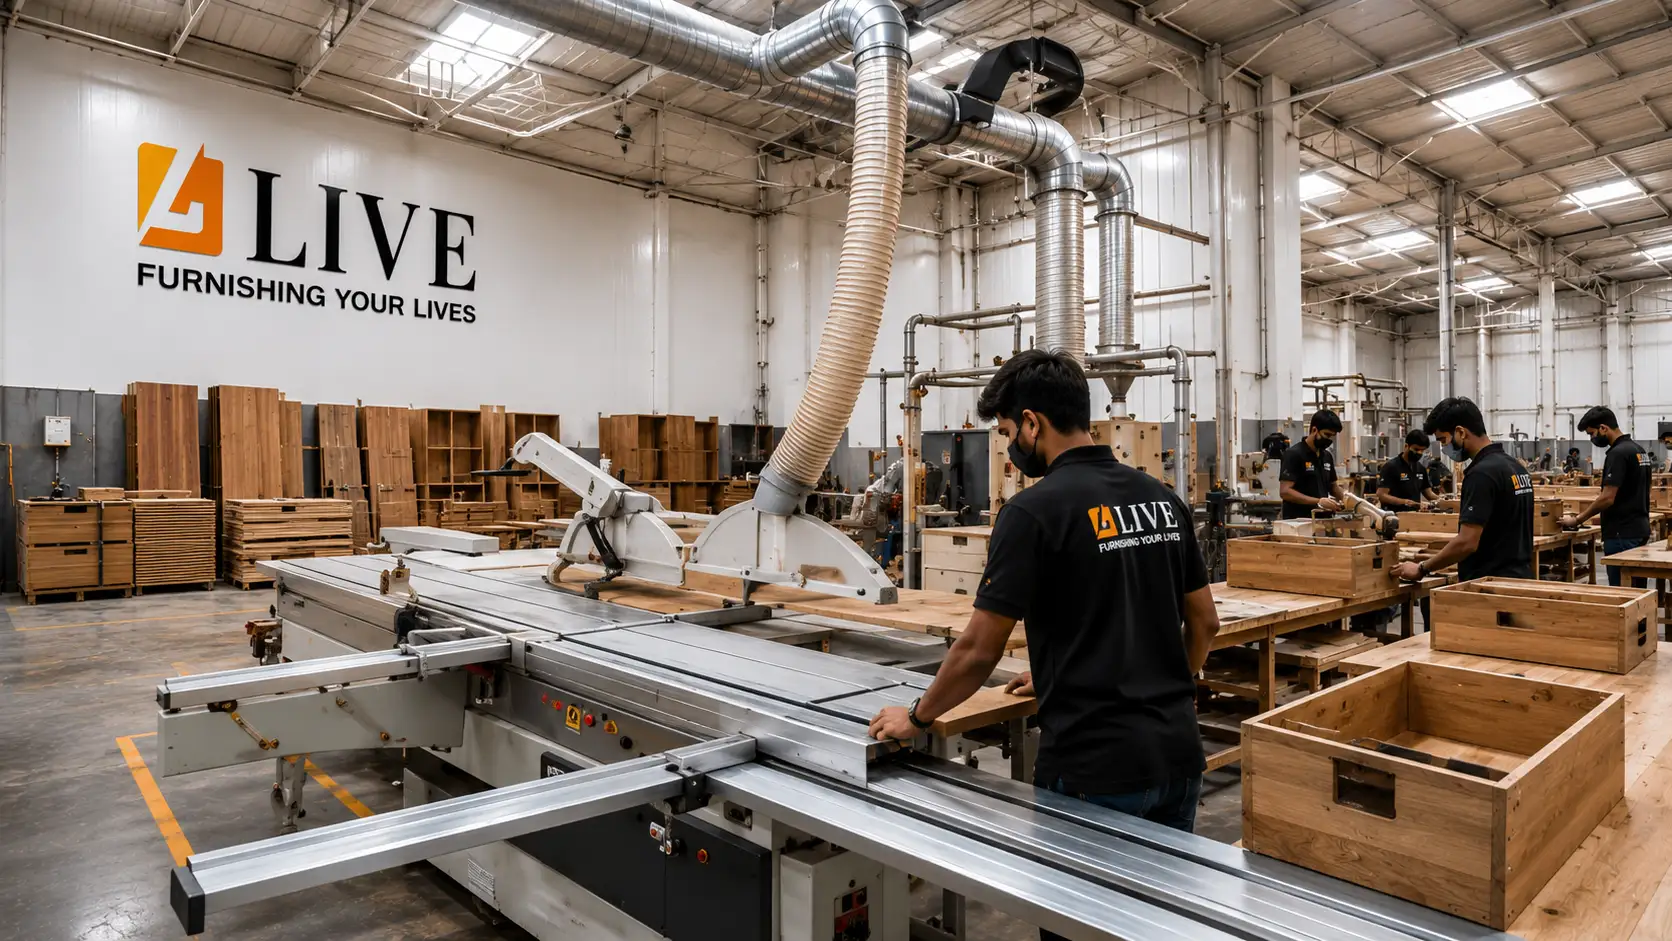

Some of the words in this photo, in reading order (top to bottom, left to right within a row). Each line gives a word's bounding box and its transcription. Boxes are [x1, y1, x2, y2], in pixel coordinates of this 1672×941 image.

[137, 262, 326, 307] FURNISHING
[334, 287, 404, 316] YOUR
[413, 298, 476, 324] LIVES
[1140, 533, 1163, 545] YOUR
